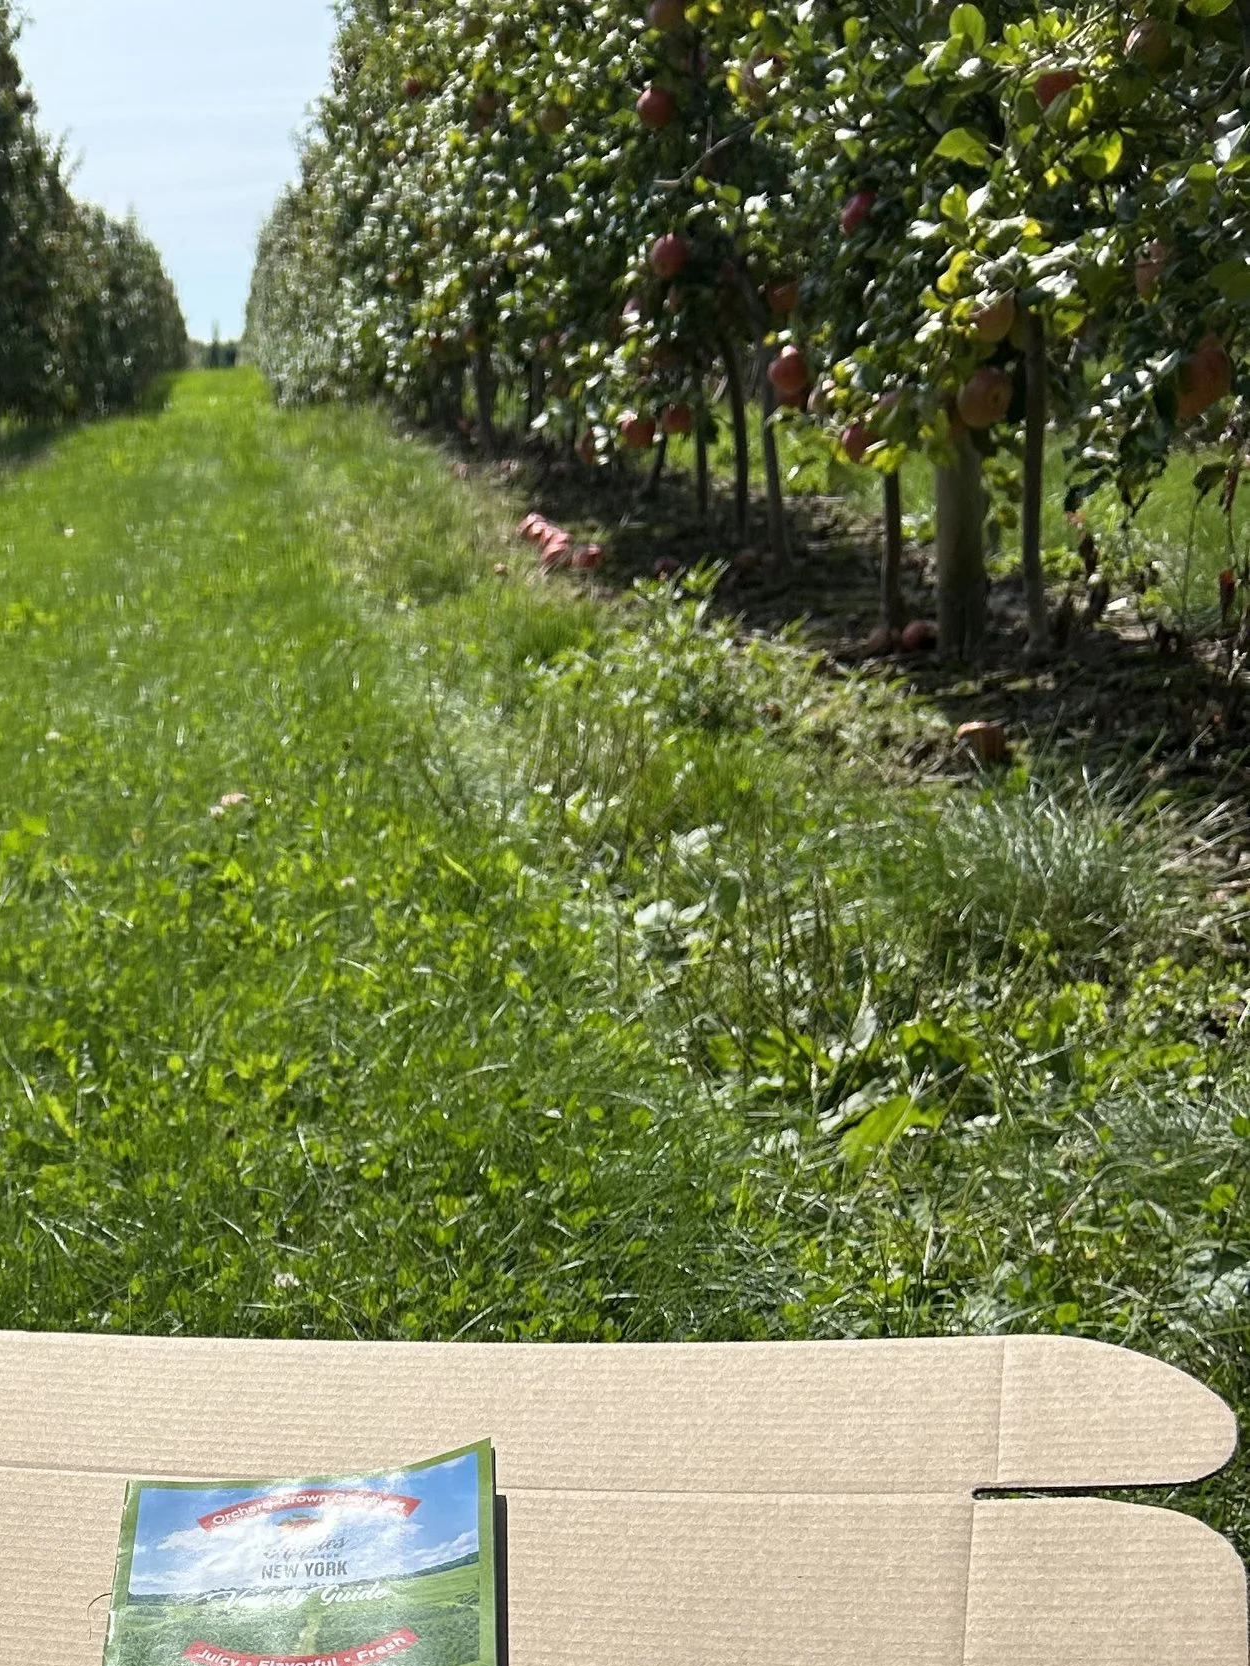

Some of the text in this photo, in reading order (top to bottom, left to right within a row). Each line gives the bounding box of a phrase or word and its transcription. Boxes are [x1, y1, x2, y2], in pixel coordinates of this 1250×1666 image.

[262, 1560, 348, 1579] NEW YORK
[316, 1581, 390, 1607] Guide
[356, 1636, 407, 1662] Fresh
